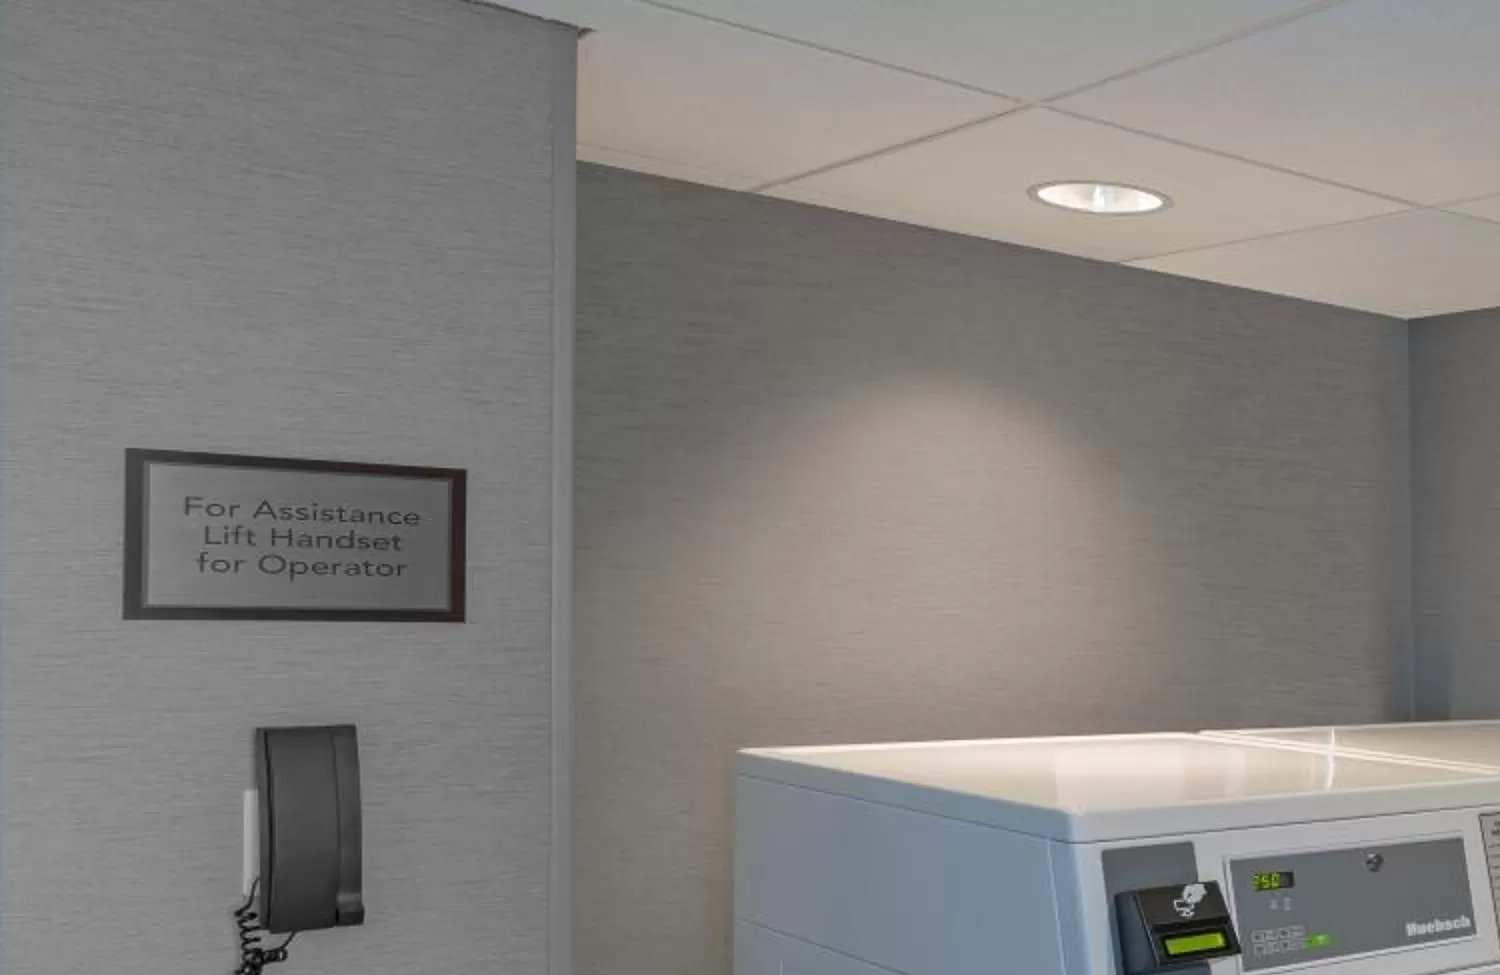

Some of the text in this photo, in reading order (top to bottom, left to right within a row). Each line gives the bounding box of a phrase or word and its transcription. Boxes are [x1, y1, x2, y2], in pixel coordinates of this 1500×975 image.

[184, 495, 421, 526] For Assistance
[204, 525, 403, 551] Lift Handset
[196, 552, 408, 582] for Operator
